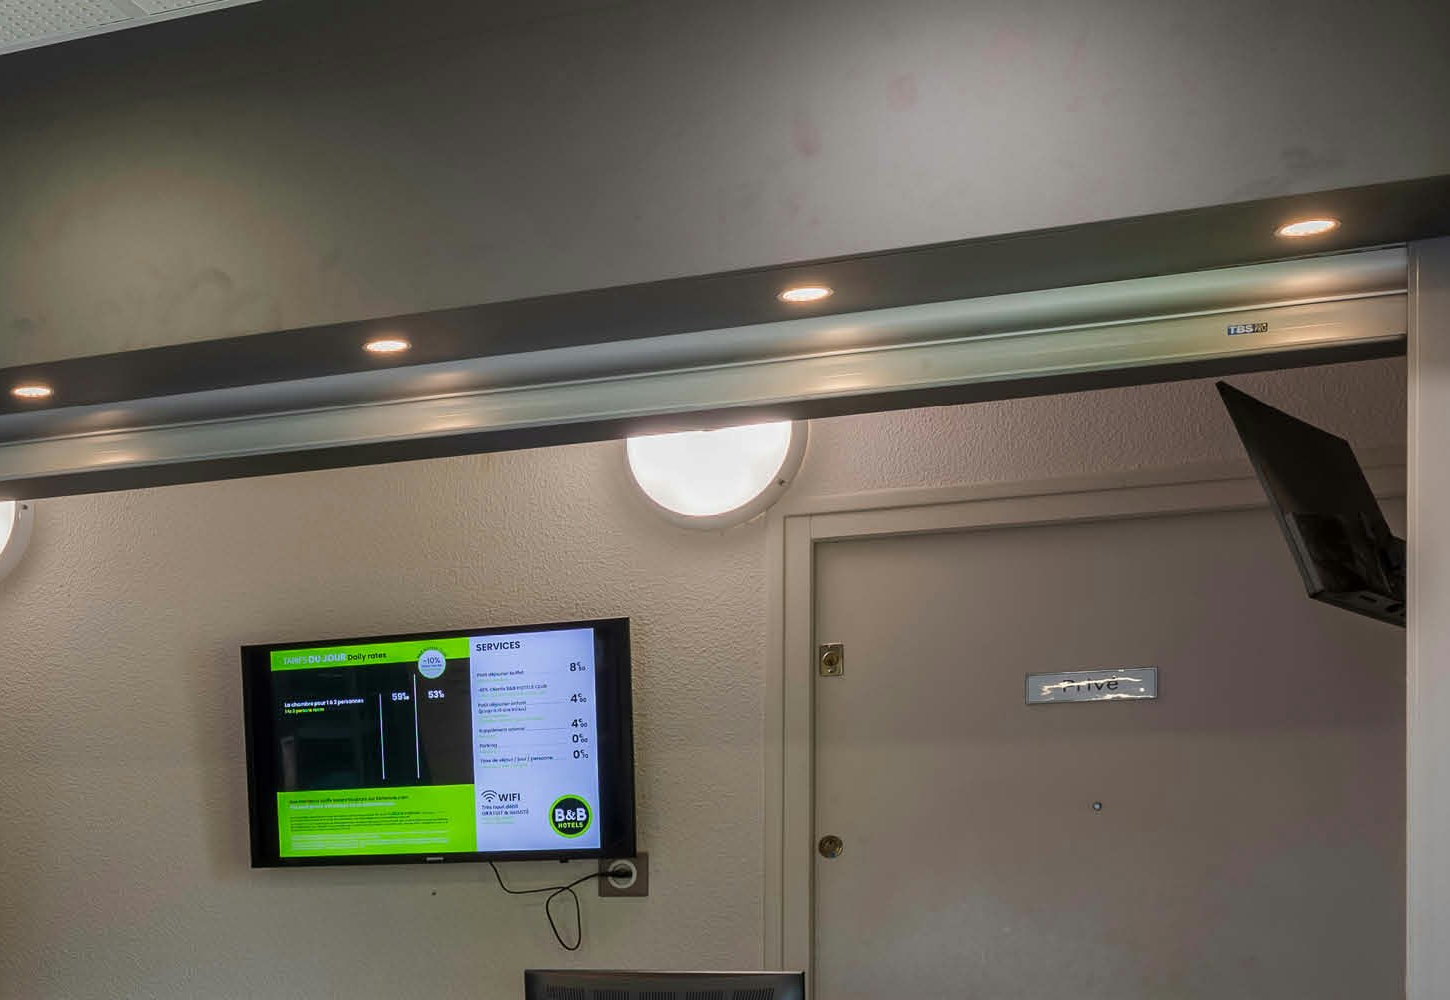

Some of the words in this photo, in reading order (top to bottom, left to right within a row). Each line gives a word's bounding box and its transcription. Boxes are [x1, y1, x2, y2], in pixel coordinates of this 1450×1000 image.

[476, 641, 521, 652] SERVICES
[308, 655, 321, 663] DU
[323, 653, 346, 662] JOUR
[347, 653, 366, 661] Daily
[423, 656, 441, 665] -10%
[498, 793, 520, 801] WIFI
[555, 807, 587, 822] B&B
